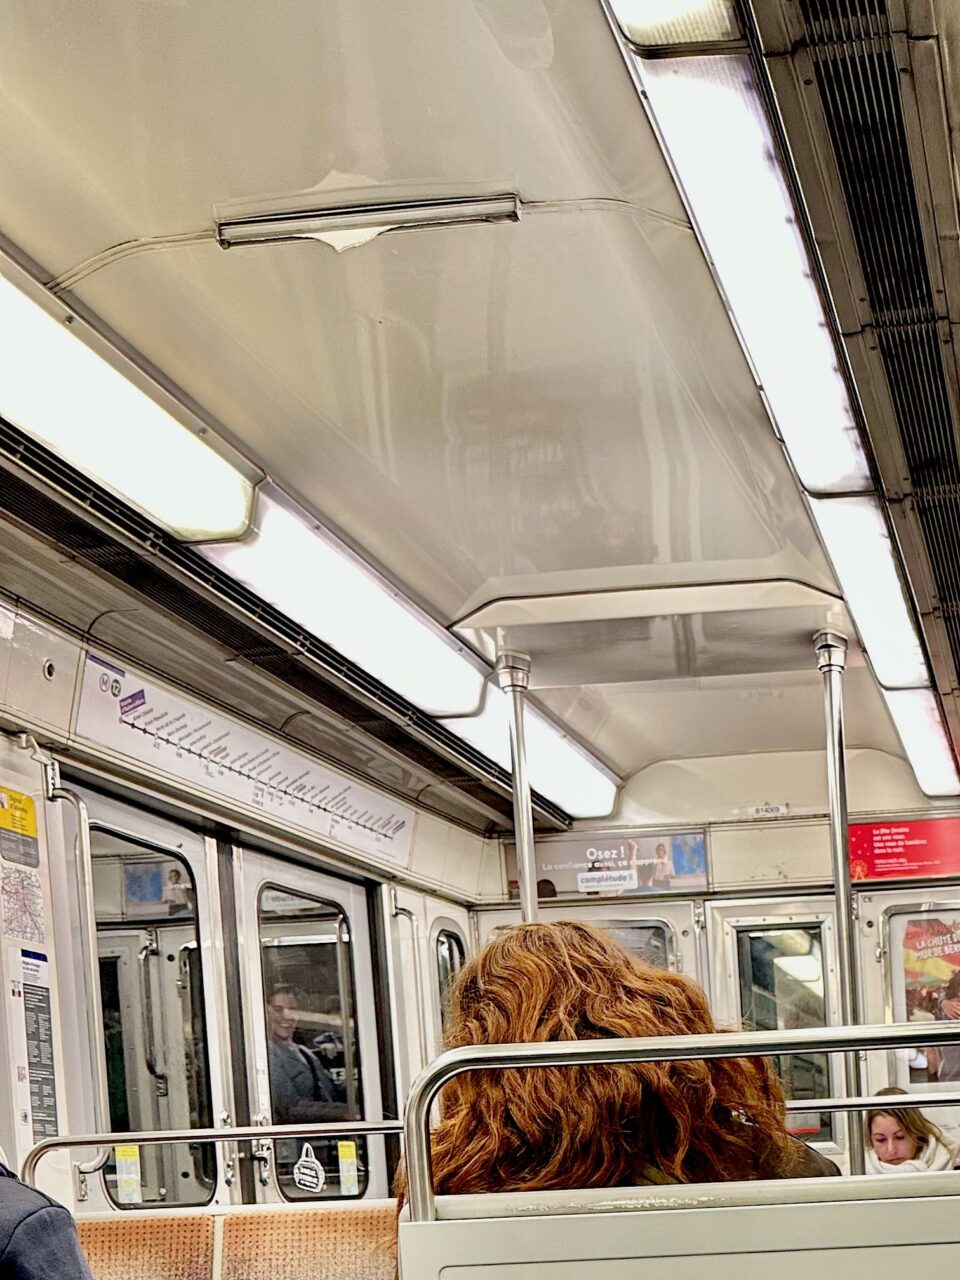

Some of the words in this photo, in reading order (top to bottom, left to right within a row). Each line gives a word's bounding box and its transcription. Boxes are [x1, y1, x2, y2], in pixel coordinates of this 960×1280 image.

[111, 681, 121, 696] 12
[586, 848, 618, 860] Osez
[620, 846, 625, 858] !
[542, 863, 553, 871] La
[553, 860, 593, 870] confiance
[580, 873, 628, 886] complétude
[916, 940, 927, 949] LA
[927, 933, 952, 947] CHUTE
[933, 946, 944, 957] DE
